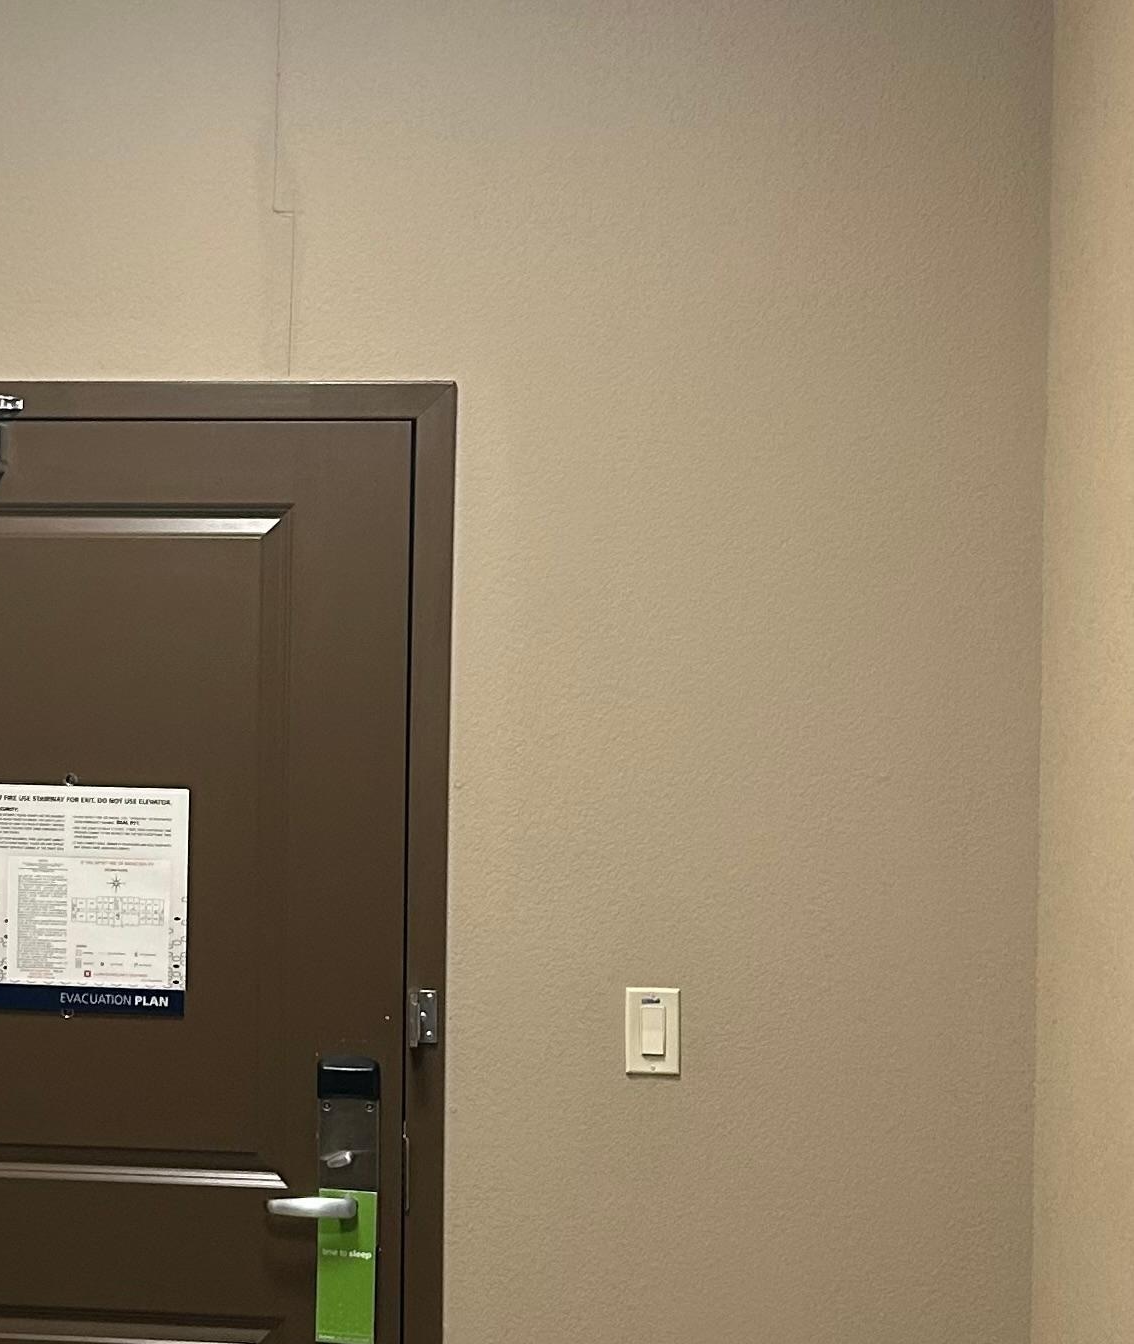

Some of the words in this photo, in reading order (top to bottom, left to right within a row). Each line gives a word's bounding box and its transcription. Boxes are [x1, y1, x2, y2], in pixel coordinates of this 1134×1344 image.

[60, 992, 132, 1006] EVACUATION
[134, 995, 169, 1007] PLAN
[348, 1250, 372, 1260] sleep
